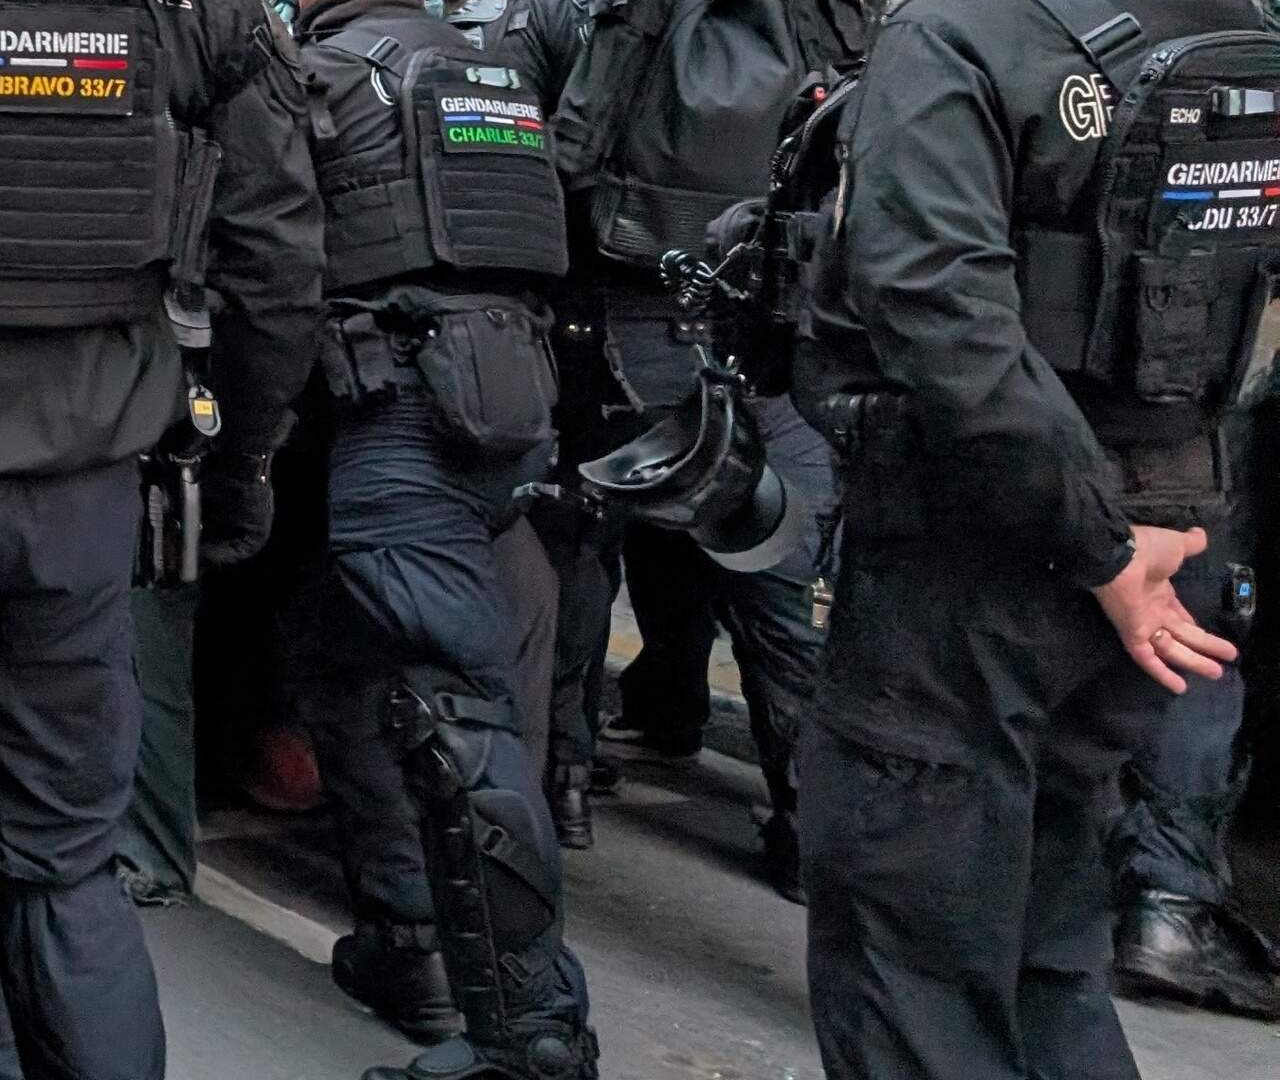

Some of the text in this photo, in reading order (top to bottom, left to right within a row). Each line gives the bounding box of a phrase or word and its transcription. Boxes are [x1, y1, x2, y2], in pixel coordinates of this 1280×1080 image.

[80, 78, 127, 98] 33/7
[441, 97, 541, 120] GENDARMERIE
[1170, 107, 1200, 124] ECHO
[448, 126, 518, 144] CHARLIE
[1237, 204, 1278, 228] 33/7
